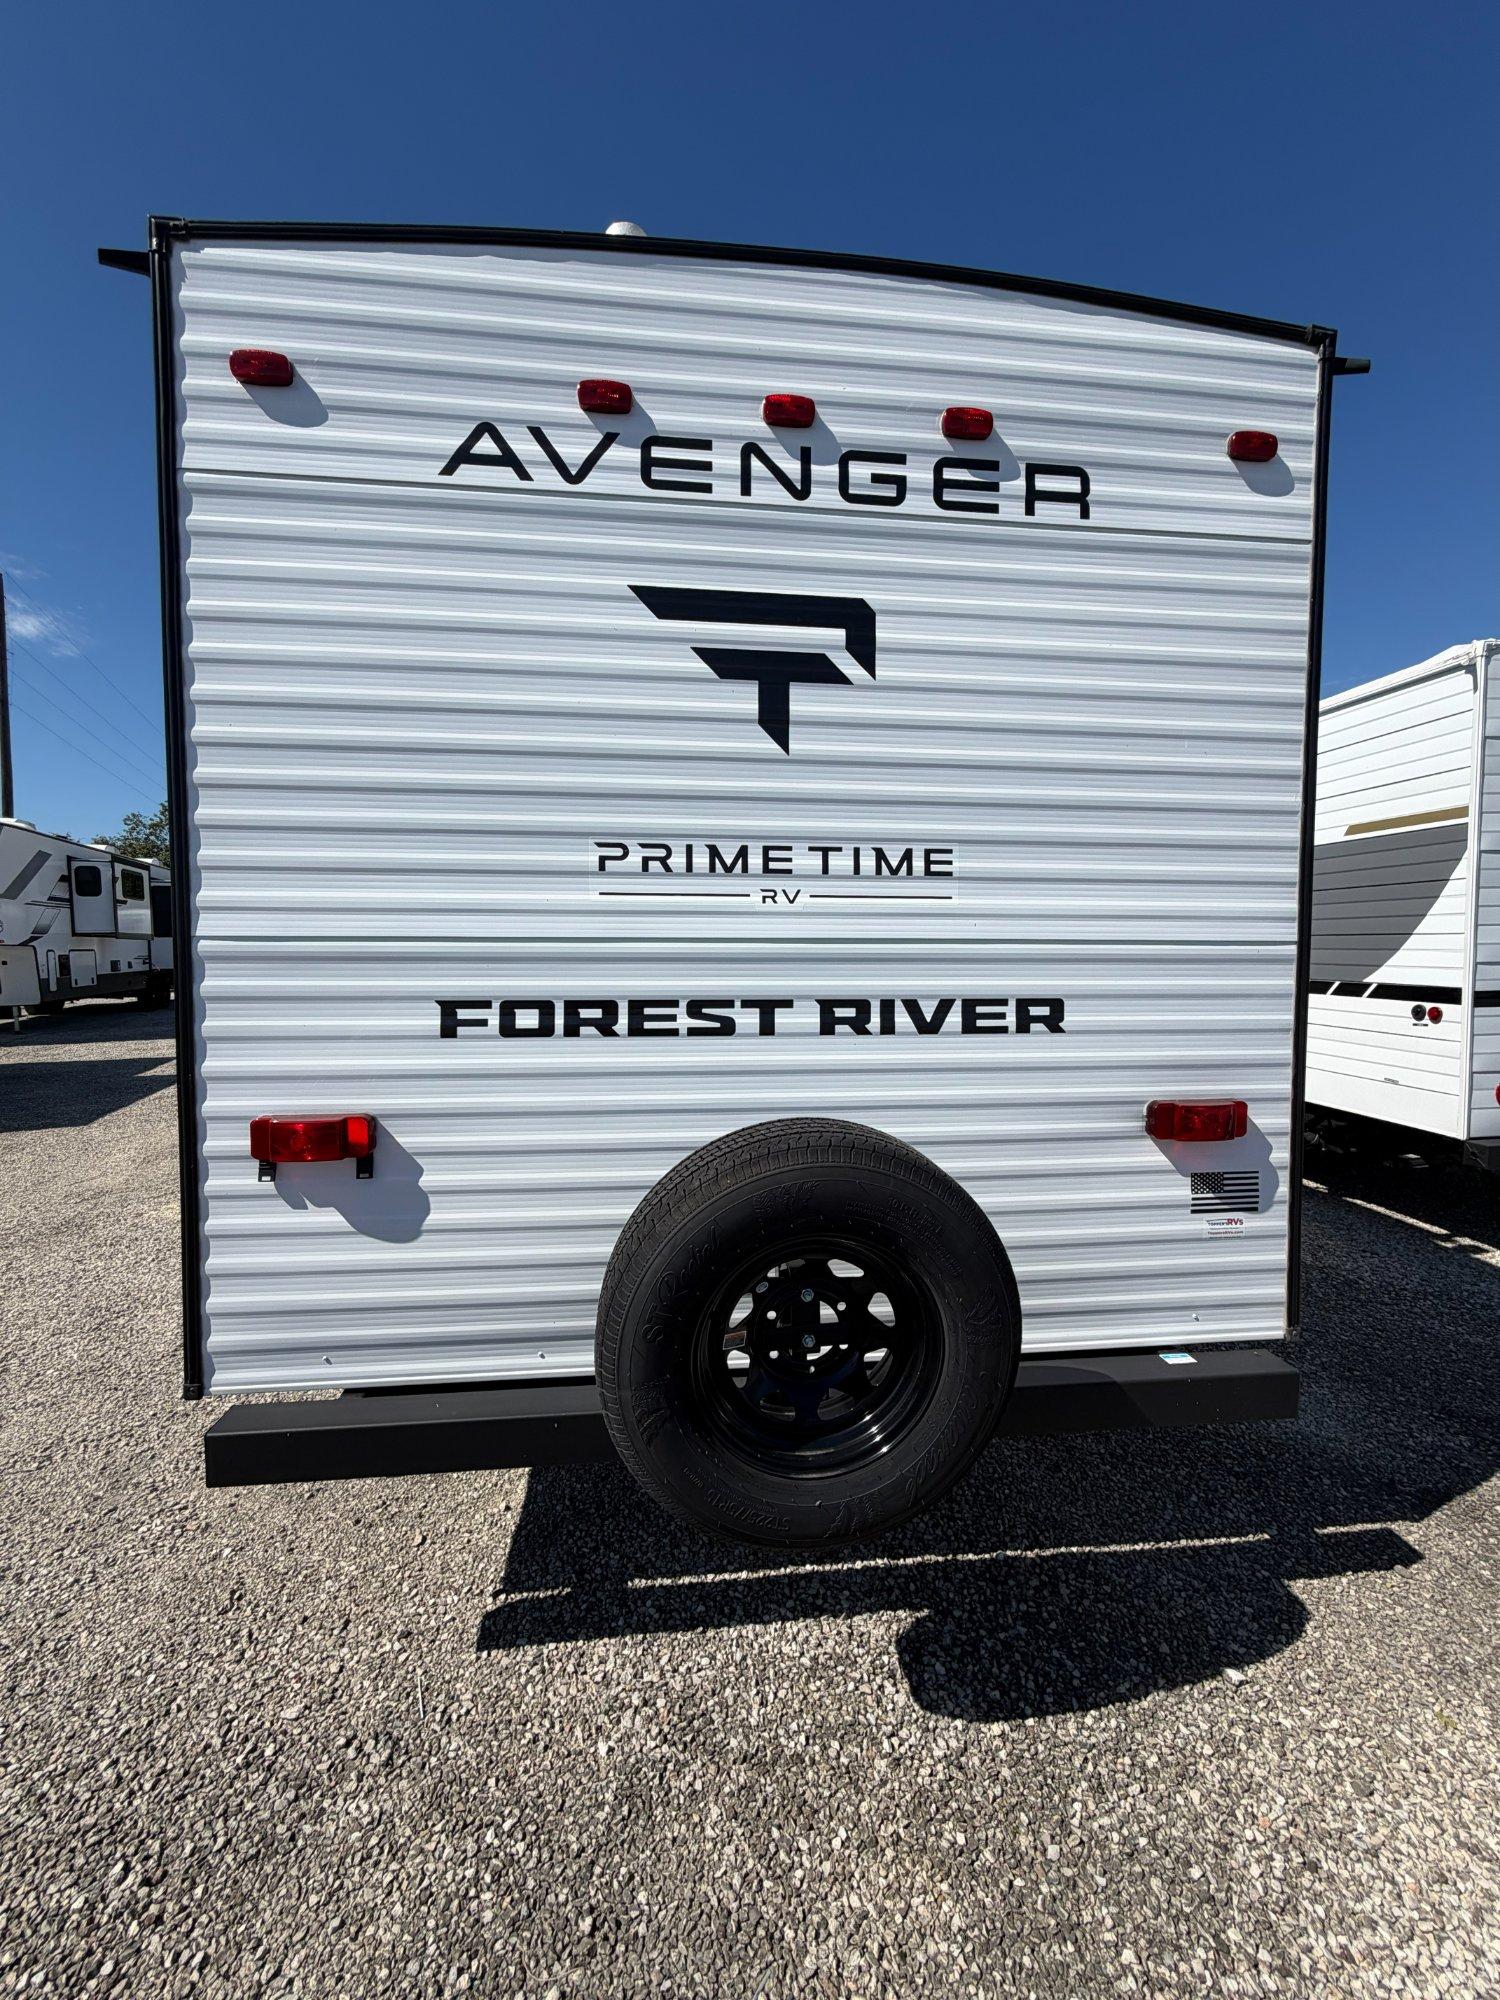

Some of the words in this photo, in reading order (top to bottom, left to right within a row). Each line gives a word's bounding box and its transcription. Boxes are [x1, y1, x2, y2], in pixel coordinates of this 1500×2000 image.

[438, 421, 1091, 520] AVENGER
[760, 888, 801, 904] RV
[435, 999, 794, 1038] FOREST
[814, 997, 1066, 1035] RIVER
